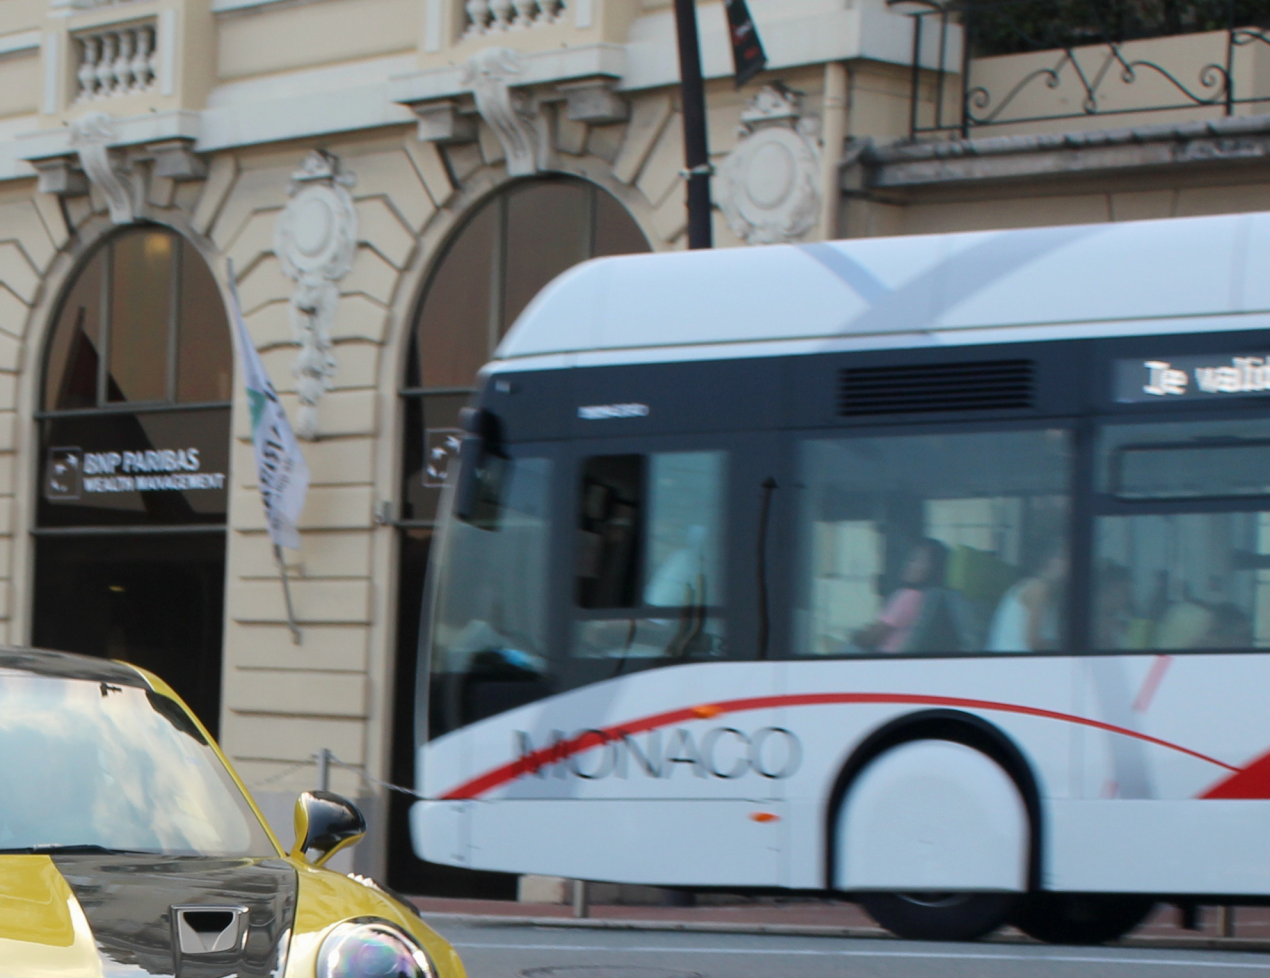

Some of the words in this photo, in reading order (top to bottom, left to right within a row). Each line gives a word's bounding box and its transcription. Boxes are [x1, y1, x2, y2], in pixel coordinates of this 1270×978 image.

[83, 452, 121, 474] BNP
[122, 448, 200, 472] PARIBAS
[83, 475, 135, 492] WEALTH
[135, 473, 226, 491] MANAGEMENT
[511, 726, 804, 780] MONACO
